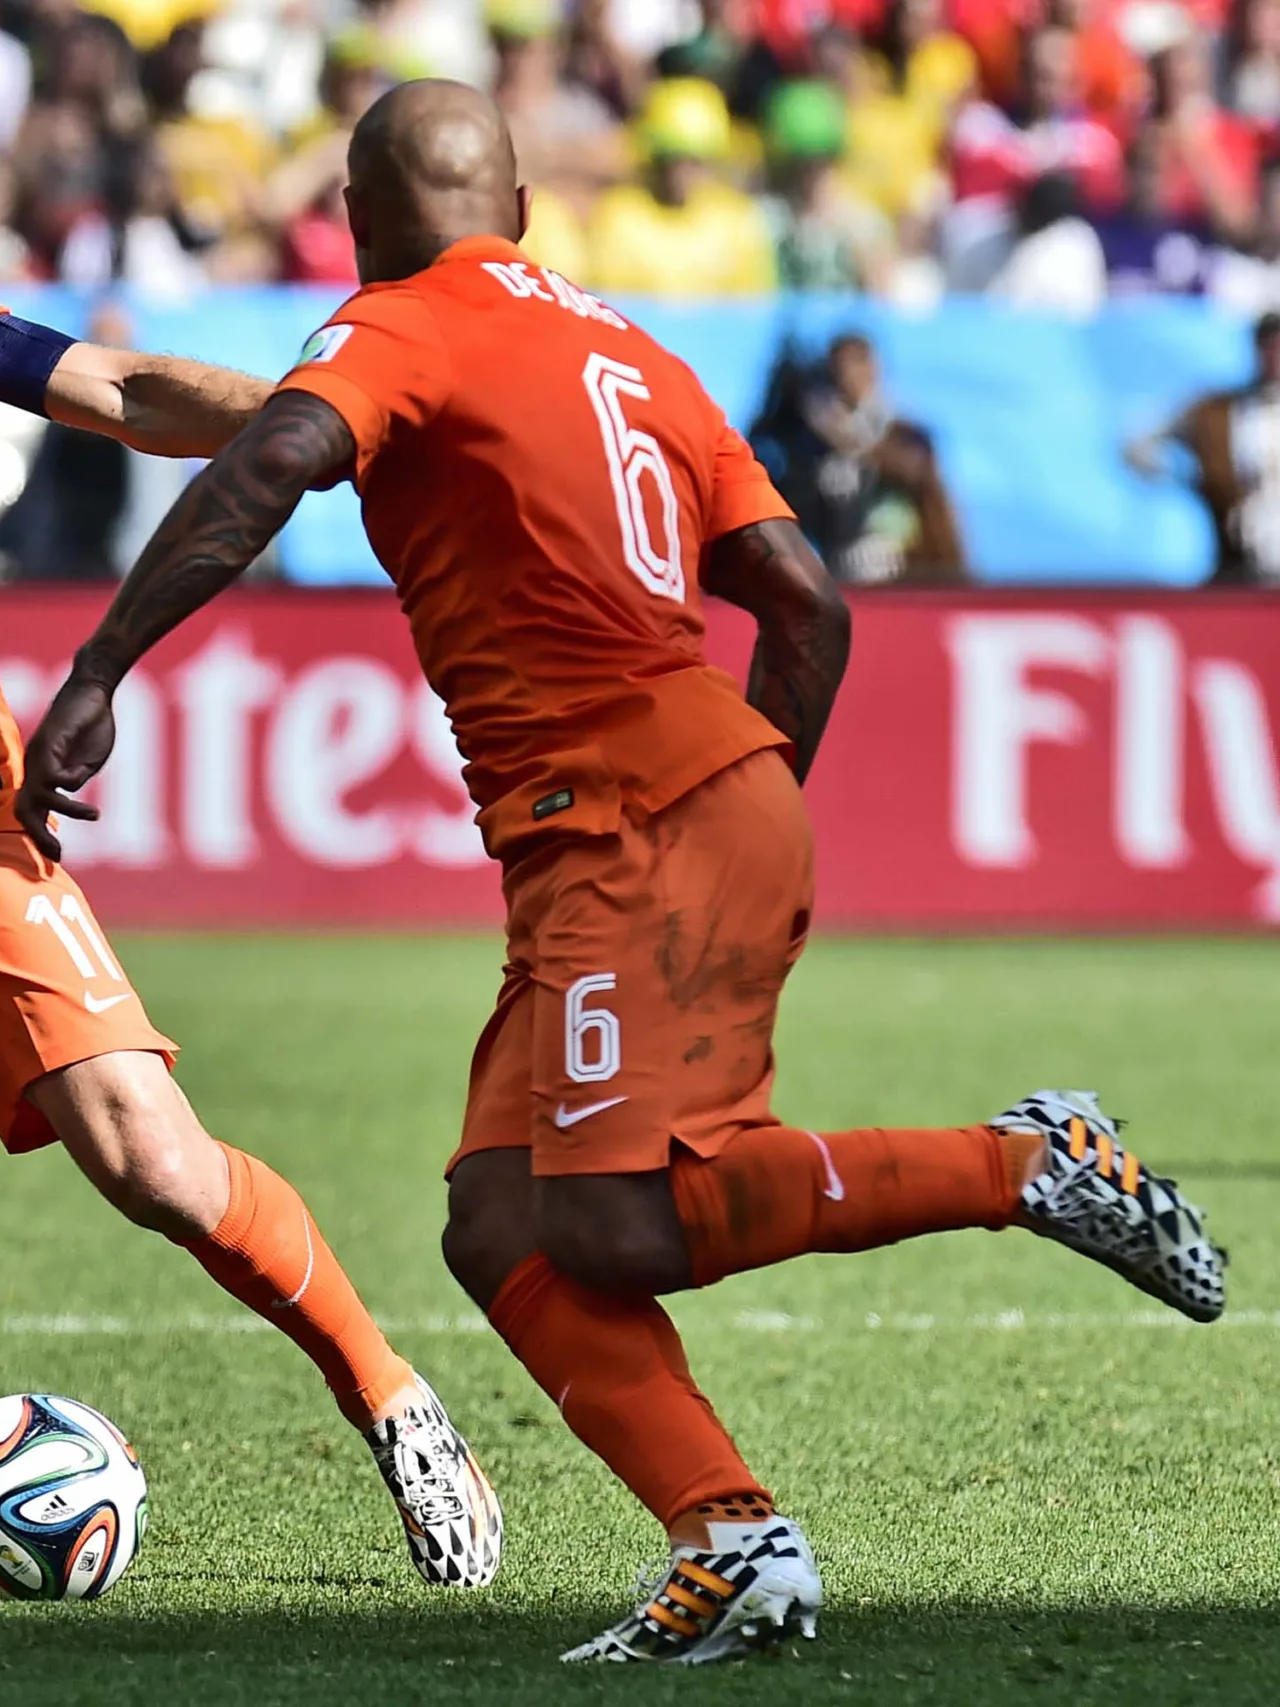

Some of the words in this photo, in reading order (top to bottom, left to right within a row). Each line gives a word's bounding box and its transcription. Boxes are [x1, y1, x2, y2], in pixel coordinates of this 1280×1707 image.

[480, 261, 556, 302] DE
[582, 351, 685, 604] 6
[24, 894, 123, 981] 11
[565, 972, 621, 1083] 6
